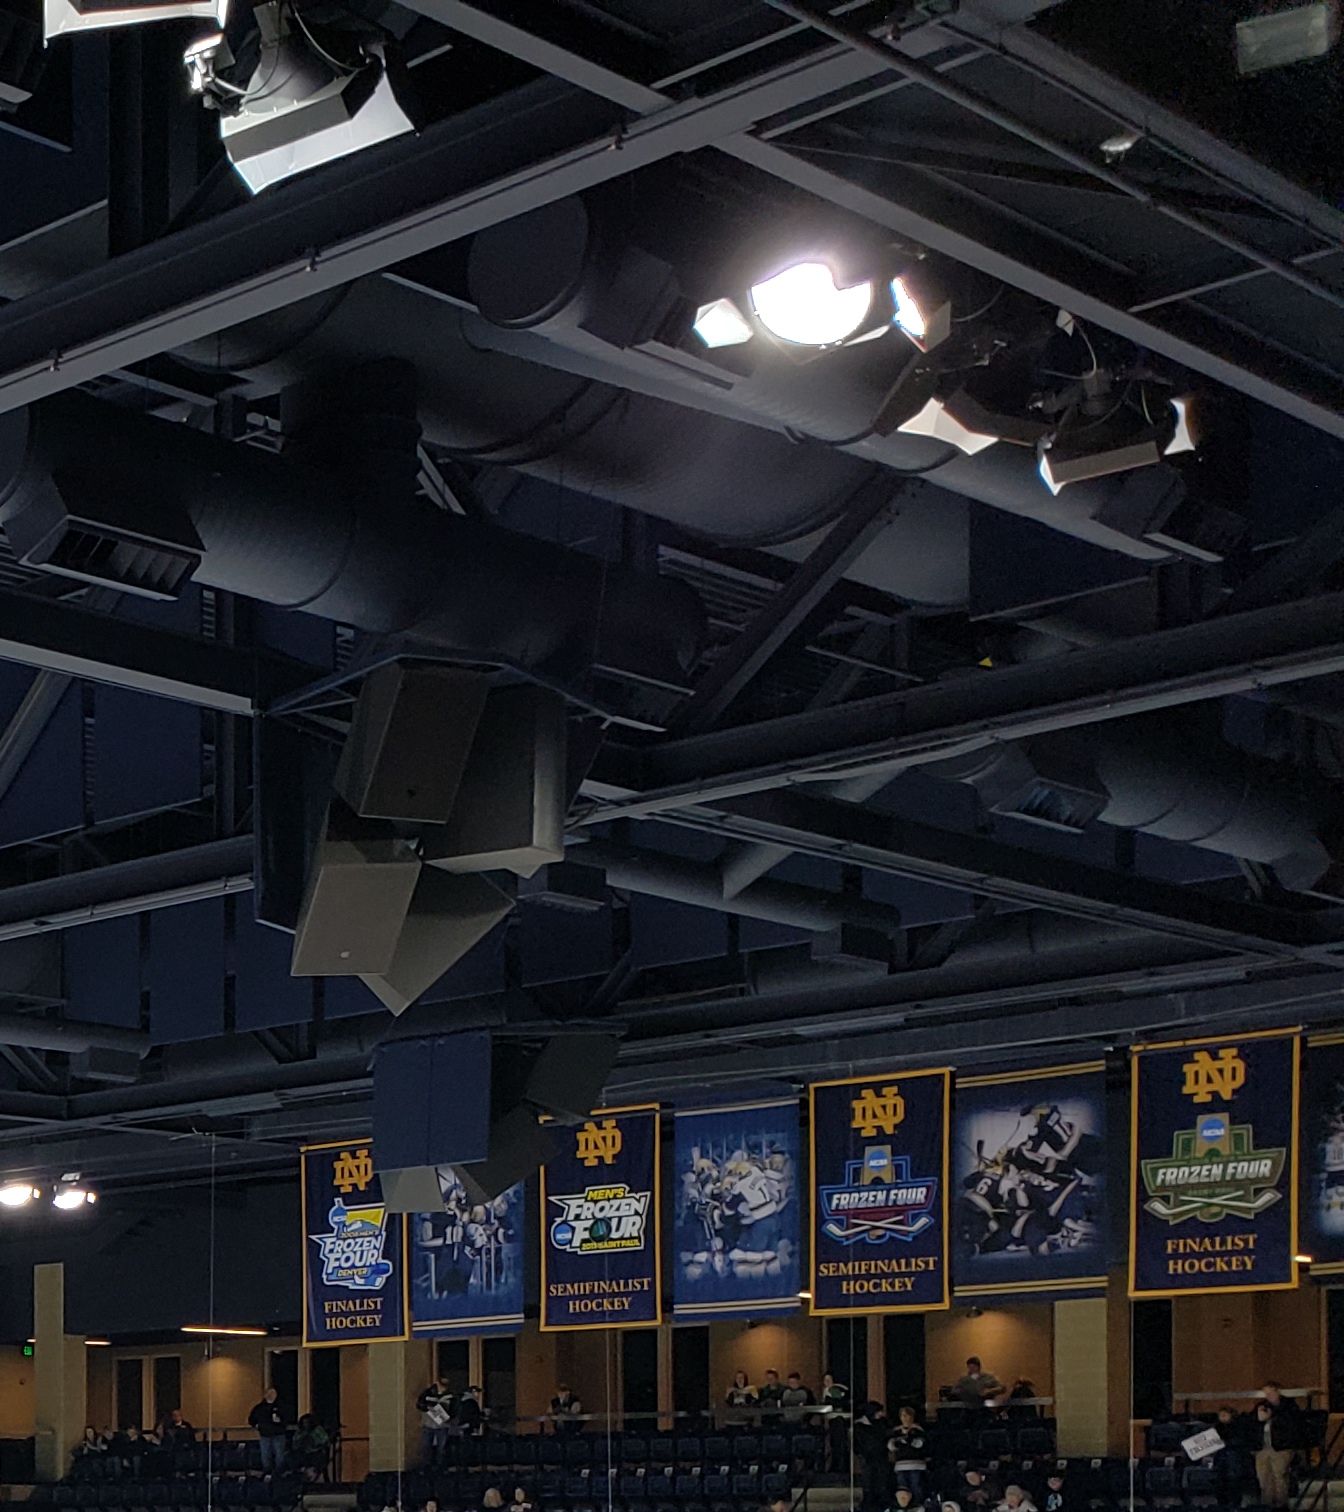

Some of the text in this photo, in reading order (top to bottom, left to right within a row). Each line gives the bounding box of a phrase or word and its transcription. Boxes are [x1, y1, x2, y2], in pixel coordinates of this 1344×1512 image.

[1156, 1159, 1272, 1186] FROZEN FOUR
[587, 1187, 625, 1200] MEN'S
[831, 1186, 927, 1210] FROZEN FOUR
[567, 1197, 647, 1220] FROZEN
[324, 1235, 381, 1255] FROZEN
[1166, 1234, 1257, 1254] FINALIST
[327, 1251, 379, 1273] FOUR
[819, 1257, 938, 1277] SEMIFINALIST
[1167, 1255, 1256, 1275] HOCKEY
[549, 1278, 651, 1296] SEMIFINALIST
[842, 1277, 915, 1294] HOCKEY
[324, 1298, 383, 1313] FINALIST
[569, 1297, 632, 1314] HOCKEY
[326, 1315, 382, 1329] HOCKEY
